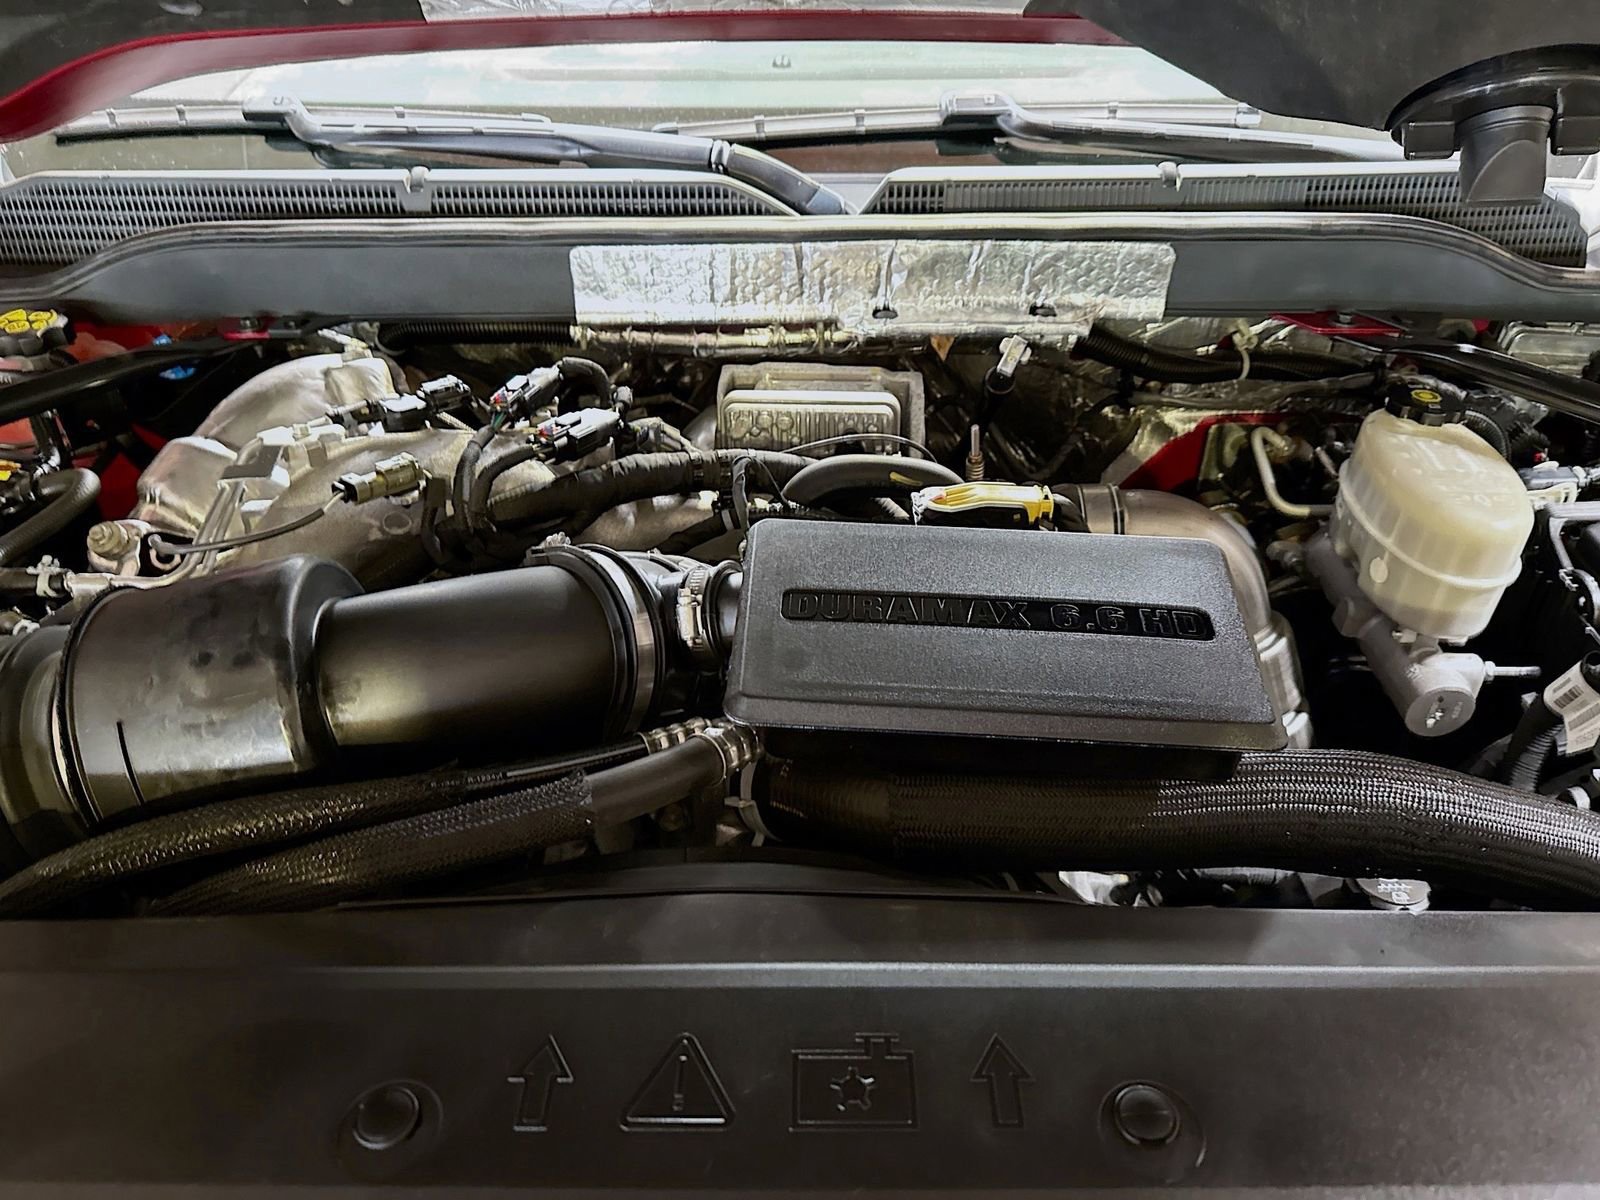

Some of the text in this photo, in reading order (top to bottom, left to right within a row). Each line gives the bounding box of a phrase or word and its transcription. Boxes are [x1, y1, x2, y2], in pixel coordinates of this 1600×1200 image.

[788, 592, 1208, 638] DURAMAX 6.6 HD
